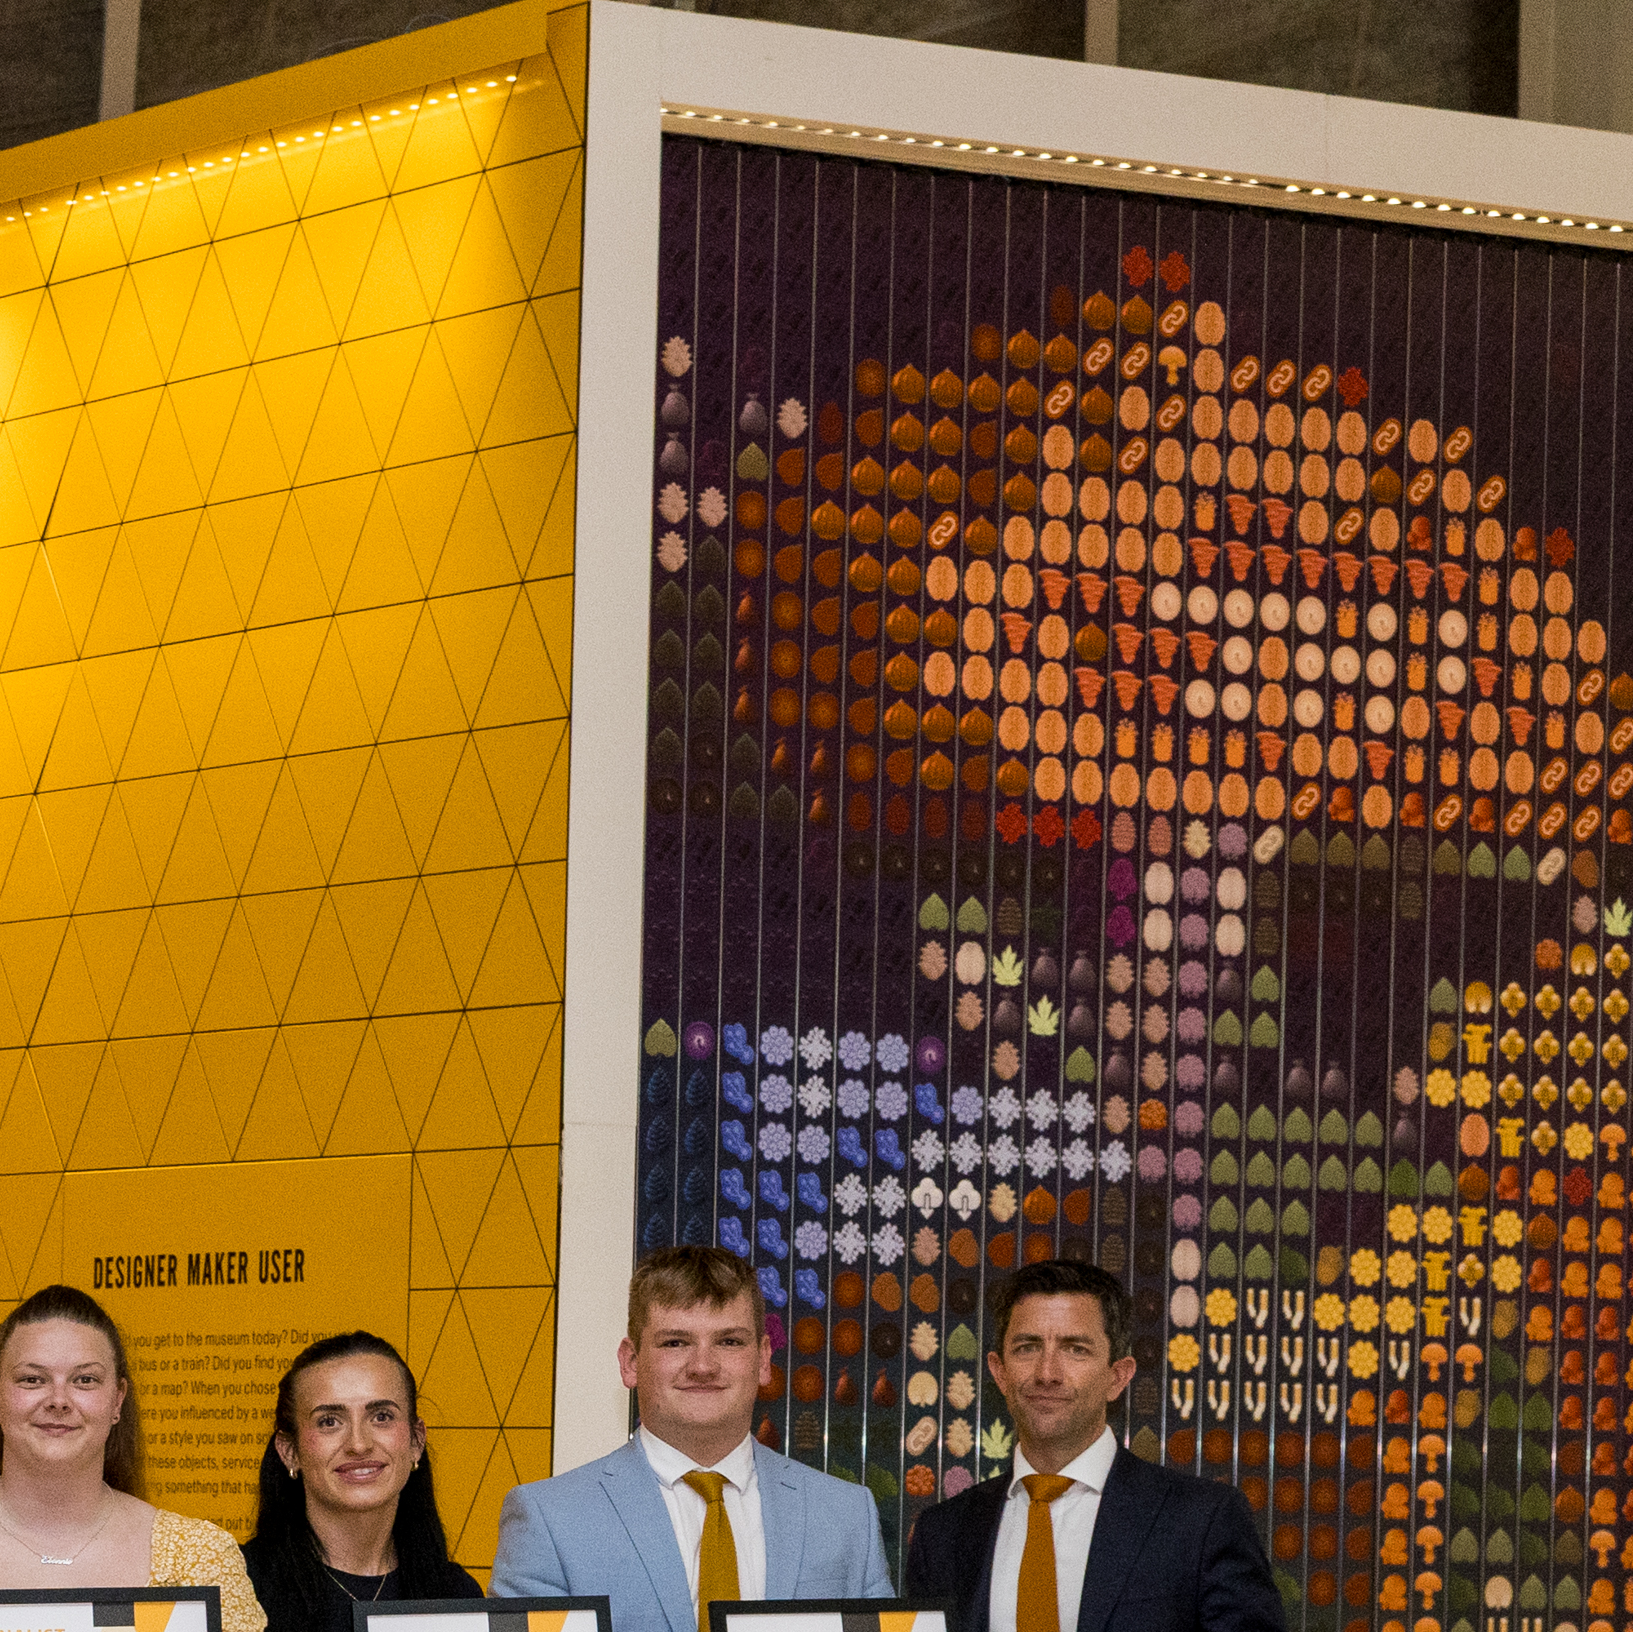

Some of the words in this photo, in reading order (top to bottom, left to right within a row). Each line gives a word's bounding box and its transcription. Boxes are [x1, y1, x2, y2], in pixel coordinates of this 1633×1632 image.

[93, 1254, 177, 1290] DESIGNER
[187, 1252, 248, 1286] MAKER
[259, 1249, 305, 1284] USER
[154, 1333, 171, 1350] get
[173, 1334, 183, 1346] to
[186, 1332, 203, 1346] the
[205, 1334, 249, 1346] museum
[252, 1330, 288, 1348] today?
[291, 1329, 309, 1344] Did
[182, 1356, 210, 1370] train?
[213, 1355, 231, 1370] Did
[234, 1358, 251, 1373] you
[255, 1355, 273, 1370] find
[161, 1381, 188, 1398] map?
[191, 1381, 220, 1394] When
[223, 1384, 241, 1398] you
[243, 1381, 276, 1396] chose
[180, 1406, 234, 1419] influenced
[236, 1406, 249, 1422] by
[169, 1431, 194, 1447] style
[196, 1433, 215, 1447] you
[217, 1434, 237, 1444] saw
[222, 1457, 261, 1470] service
[165, 1480, 219, 1497] something
[221, 1480, 241, 1494] that
